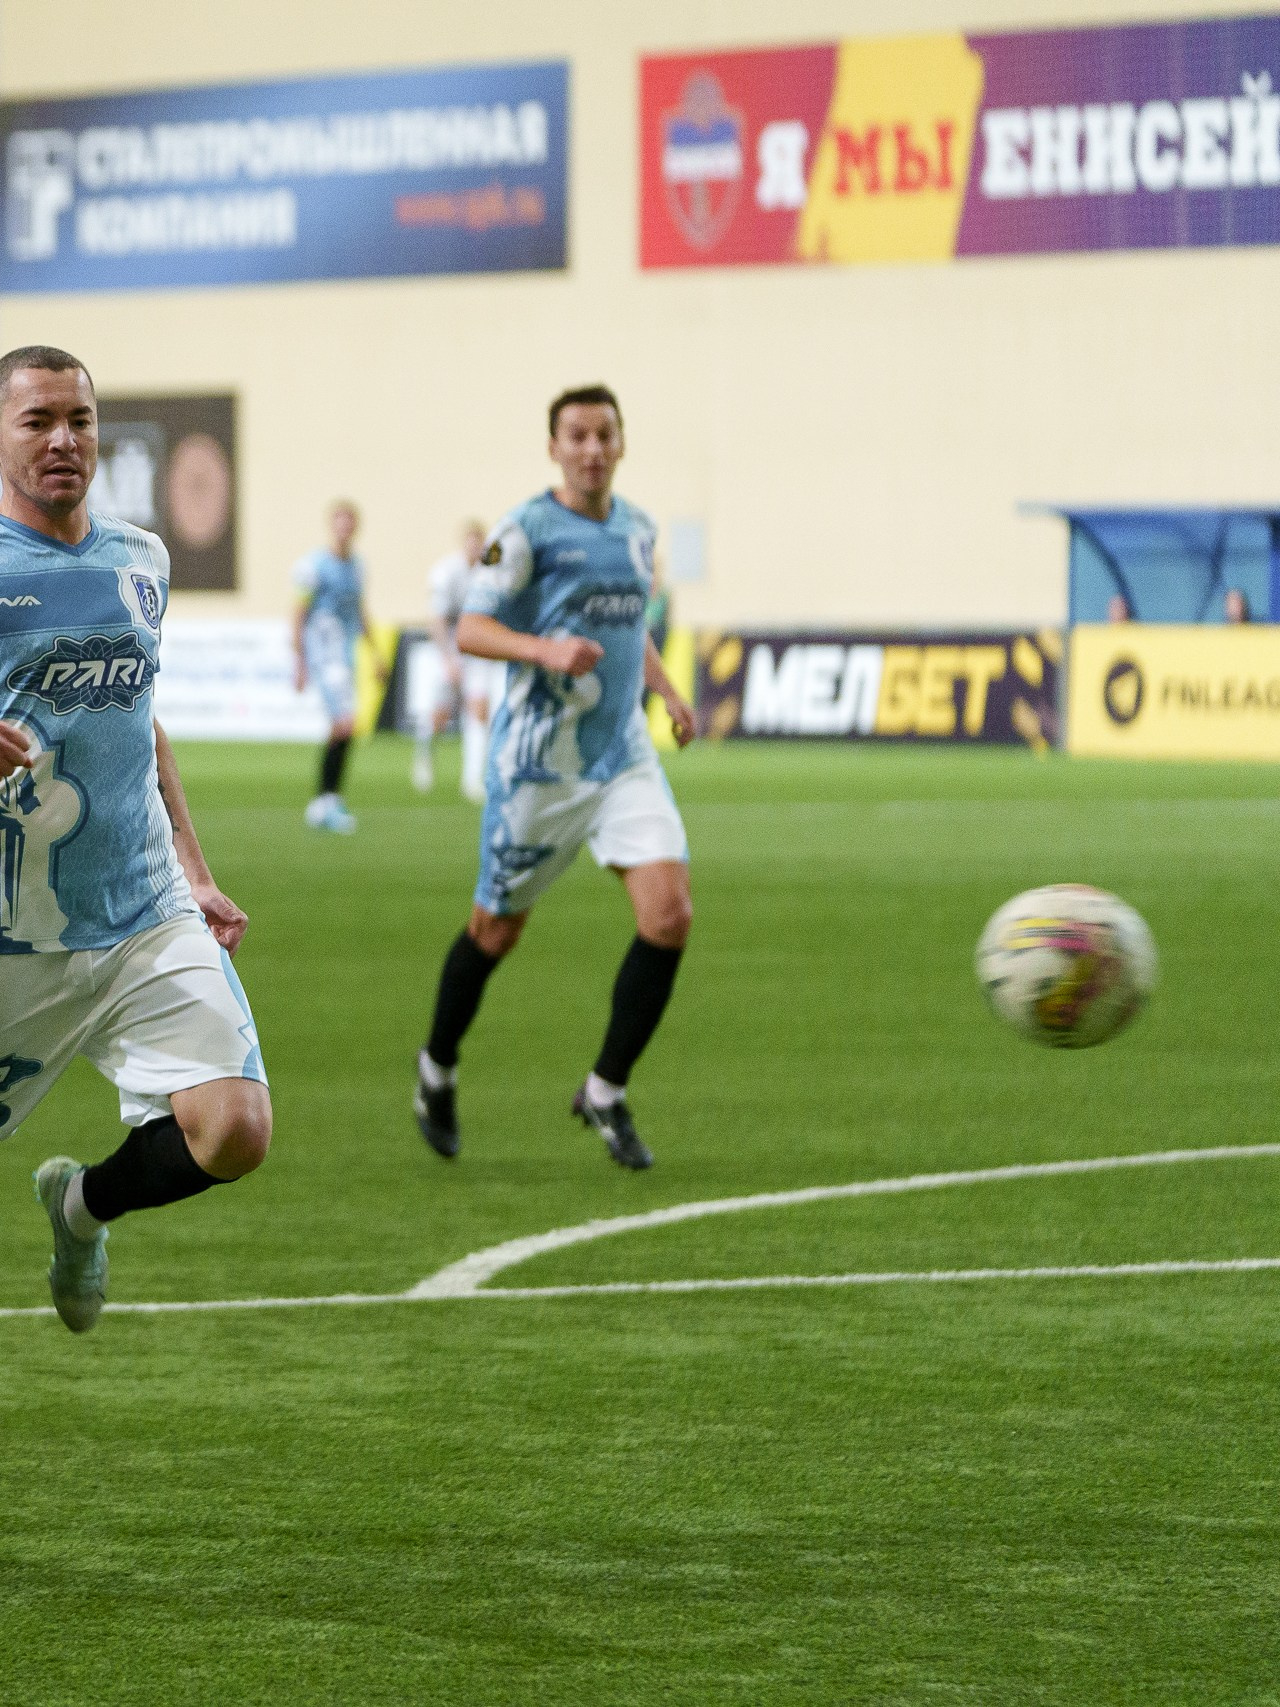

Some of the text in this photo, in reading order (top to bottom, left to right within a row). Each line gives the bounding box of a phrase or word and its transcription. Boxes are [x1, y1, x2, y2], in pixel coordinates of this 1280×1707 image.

[754, 70, 1280, 211] Я МЫ ЕНИСЕЙ
[78, 186, 297, 256] КОМПАНИЯ
[40, 658, 146, 691] PARI
